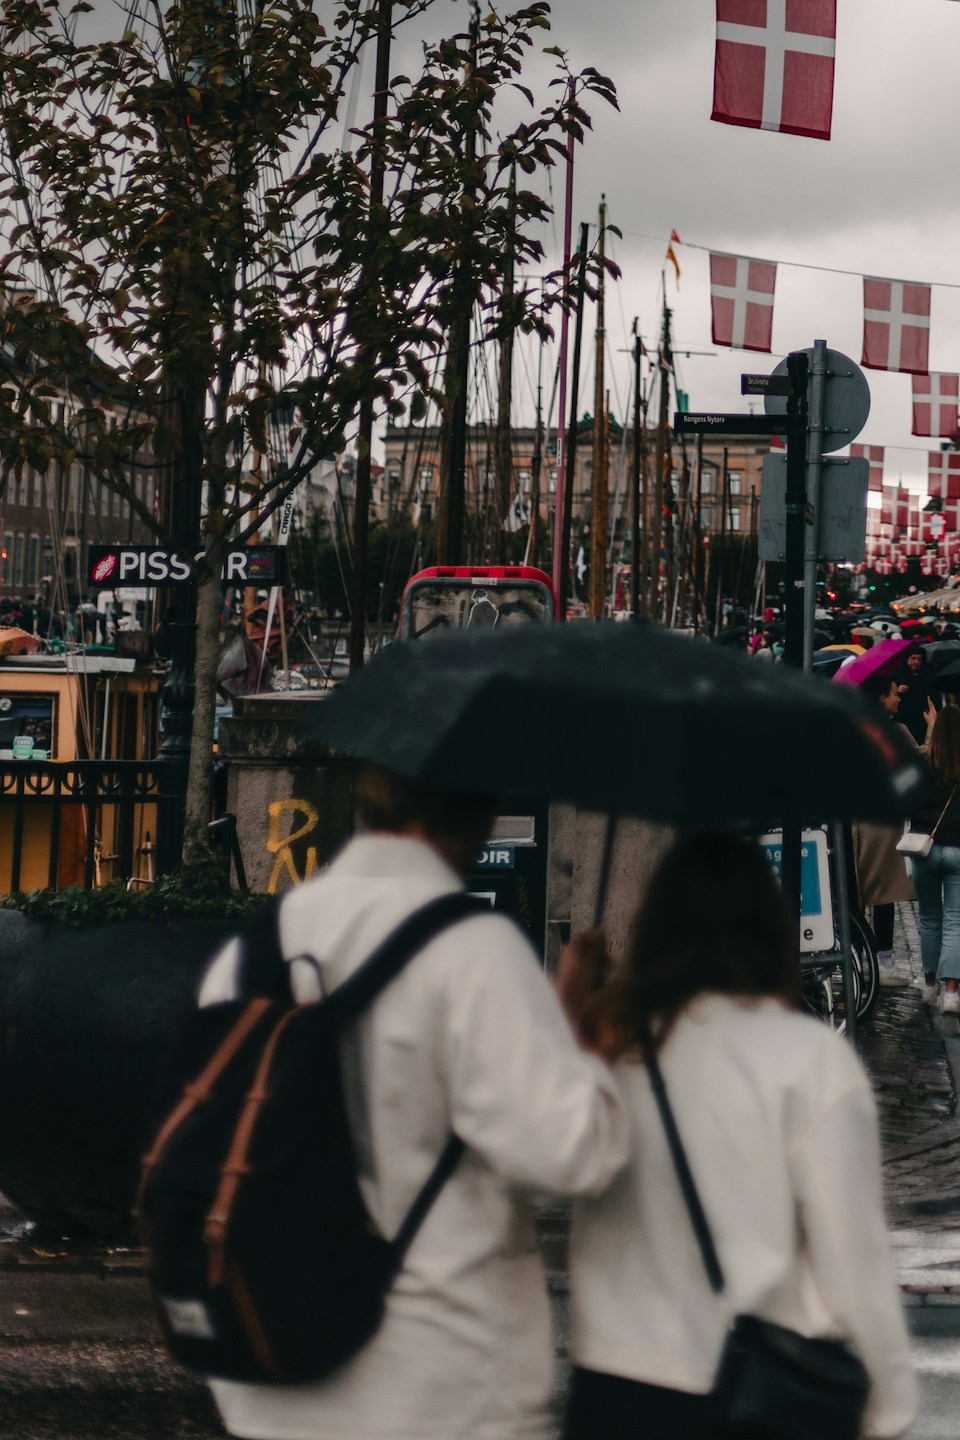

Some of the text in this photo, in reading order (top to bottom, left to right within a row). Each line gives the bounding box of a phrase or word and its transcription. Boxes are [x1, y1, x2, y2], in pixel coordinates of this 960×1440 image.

[683, 415, 725, 425] Kongens Nytorv
[281, 503, 292, 535] CARGO
[119, 551, 248, 581] PISSR
